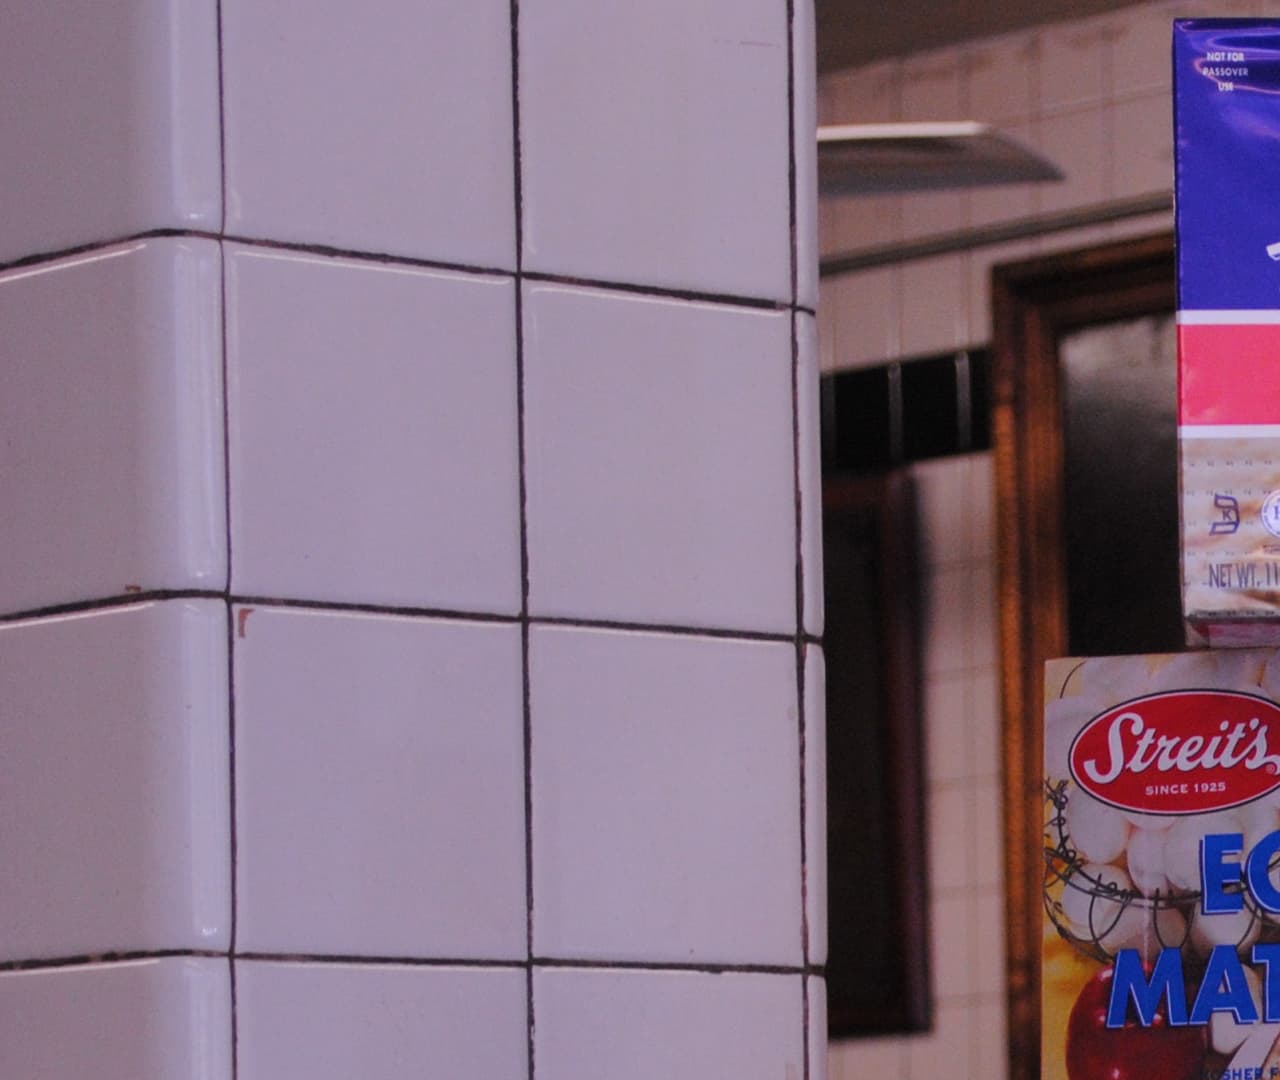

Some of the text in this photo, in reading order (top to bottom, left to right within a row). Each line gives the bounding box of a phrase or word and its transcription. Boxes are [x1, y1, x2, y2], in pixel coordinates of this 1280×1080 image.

[1206, 51, 1245, 62] NOT FOR
[1202, 67, 1249, 77] PASSOVER
[1208, 563, 1232, 588] NET
[1236, 561, 1260, 587] WT.
[1266, 562, 1278, 586] 11
[1145, 782, 1226, 796] SINCE 1925
